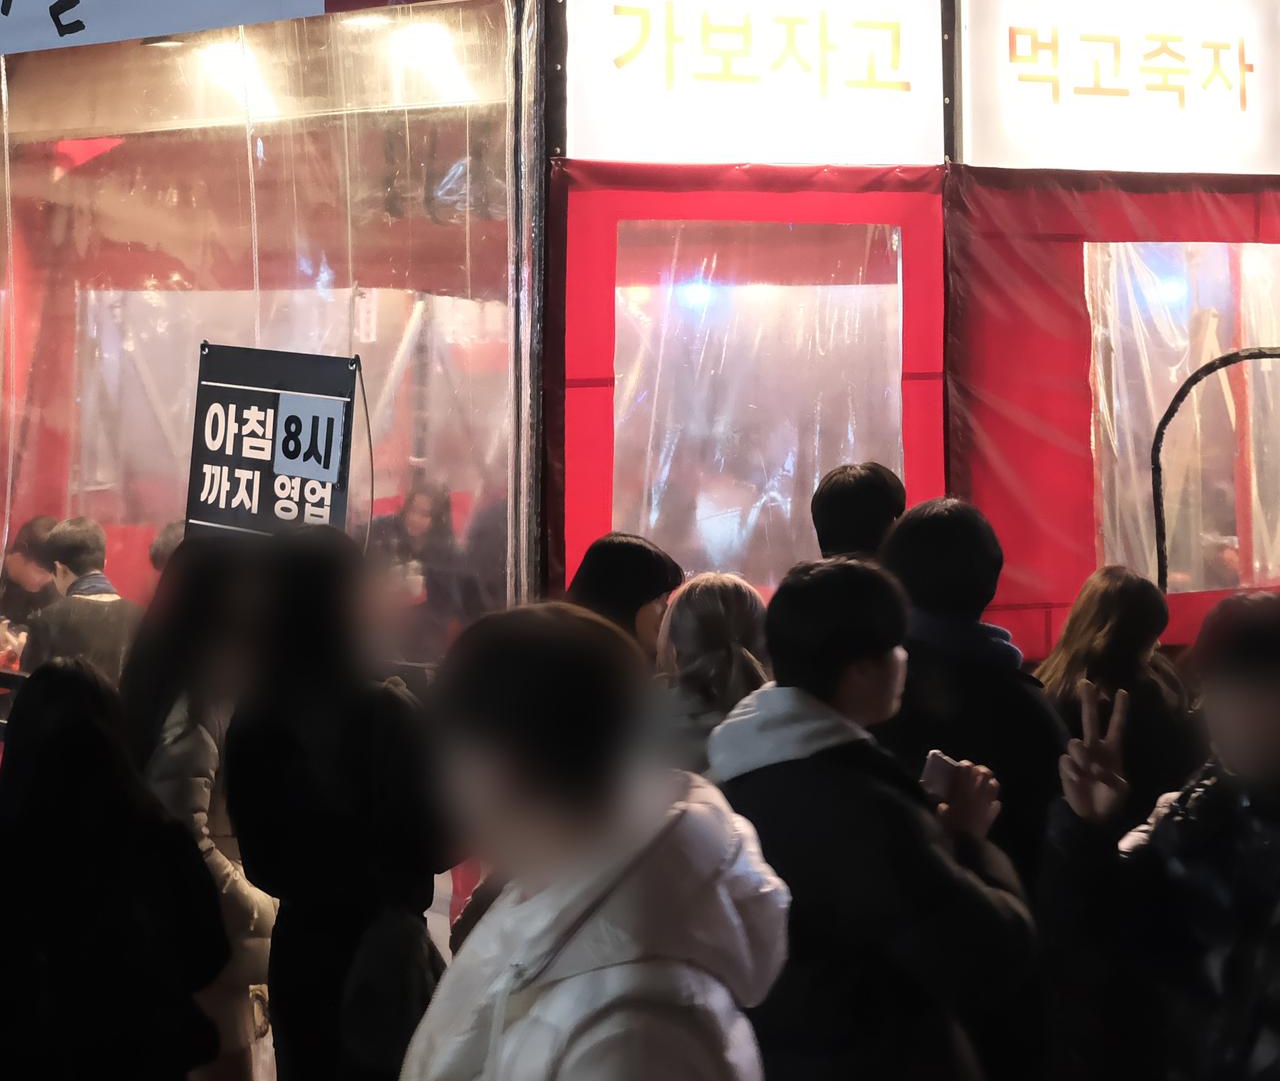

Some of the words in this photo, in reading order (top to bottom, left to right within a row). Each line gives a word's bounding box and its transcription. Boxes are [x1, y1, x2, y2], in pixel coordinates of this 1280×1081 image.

[612, 1, 913, 98] 가보자고
[1008, 23, 1255, 112] 먹고죽자
[204, 402, 274, 461] 아침
[282, 414, 335, 470] 8시
[200, 464, 261, 514] 까지
[273, 474, 333, 525] 영업
